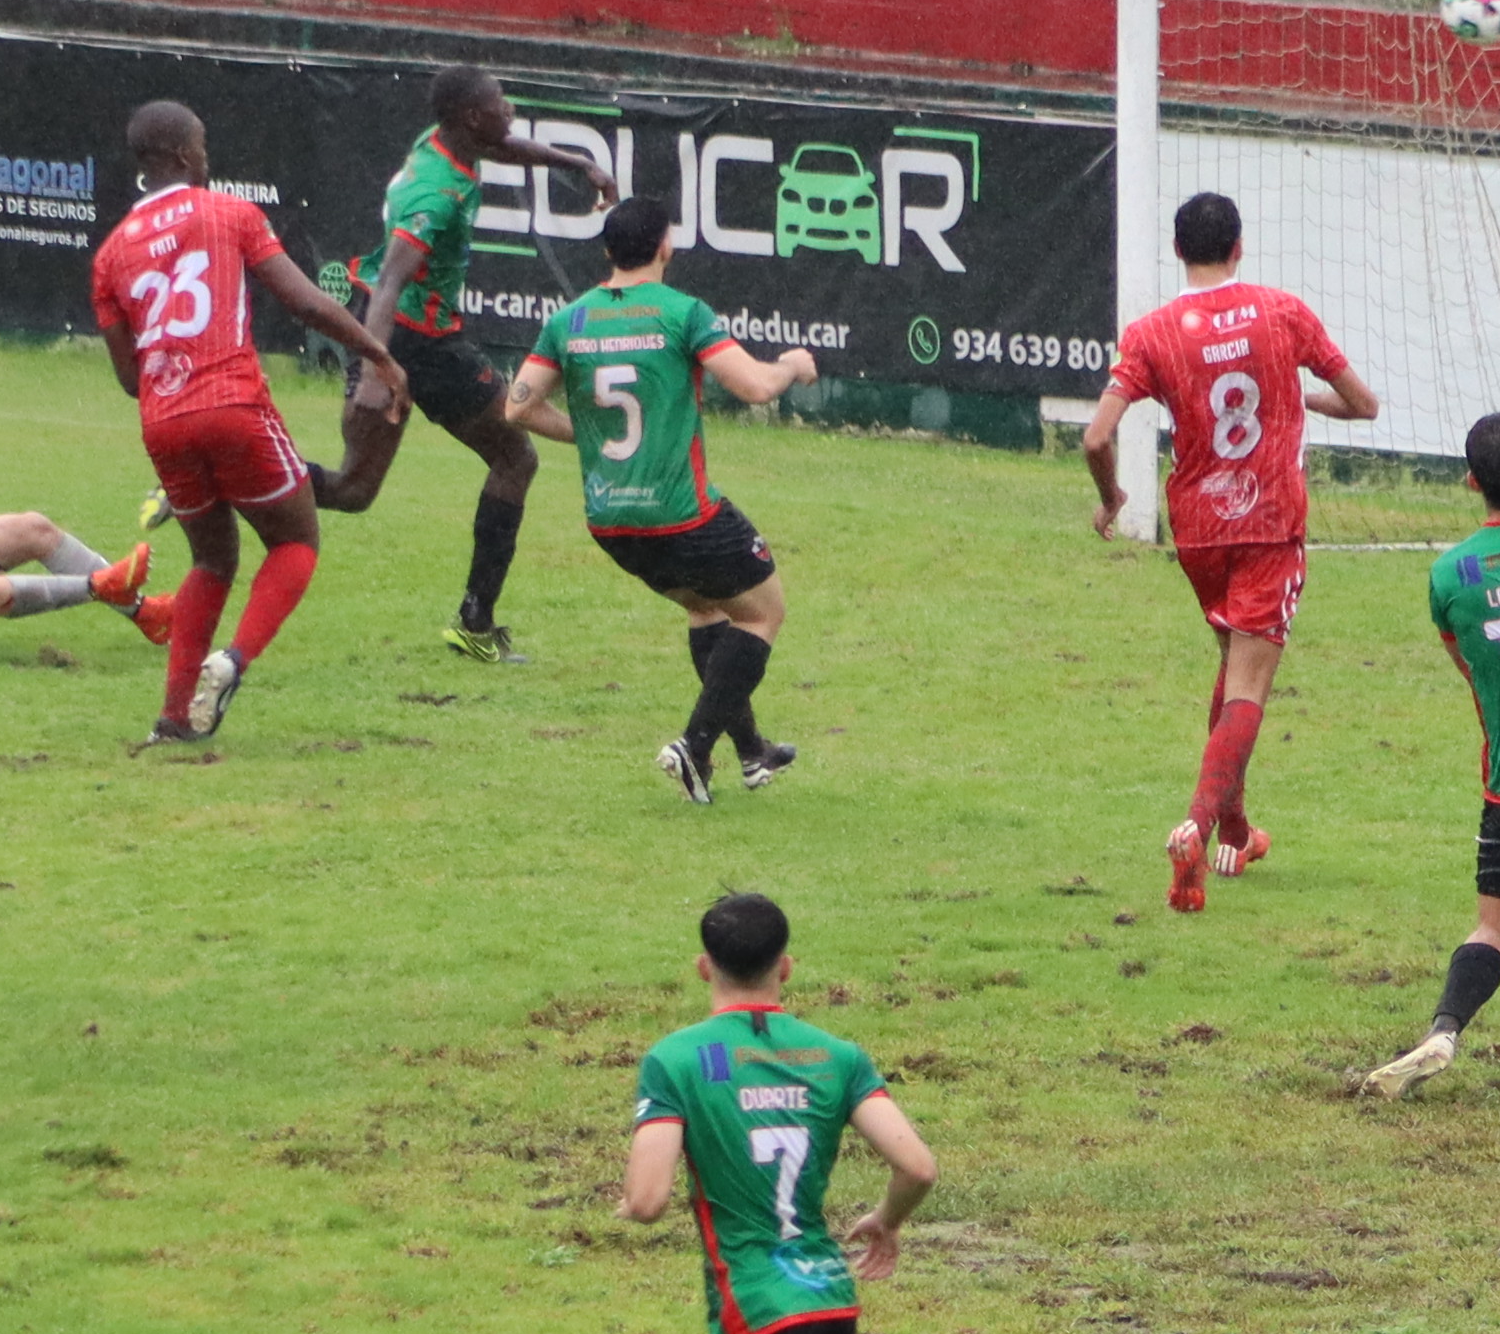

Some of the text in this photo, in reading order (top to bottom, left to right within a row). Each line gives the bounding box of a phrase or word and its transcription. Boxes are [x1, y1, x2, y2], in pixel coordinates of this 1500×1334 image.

[6, 195, 27, 216] DE
[29, 197, 97, 223] SEGUROS
[208, 179, 280, 205] MOREIRA
[129, 249, 213, 350] 23
[952, 327, 1117, 372] 934 639 801
[1201, 338, 1251, 365] GARCIA
[595, 364, 643, 462] 5
[1209, 371, 1263, 461] 8
[739, 1085, 809, 1111] DUARTE
[748, 1126, 810, 1241] 7
